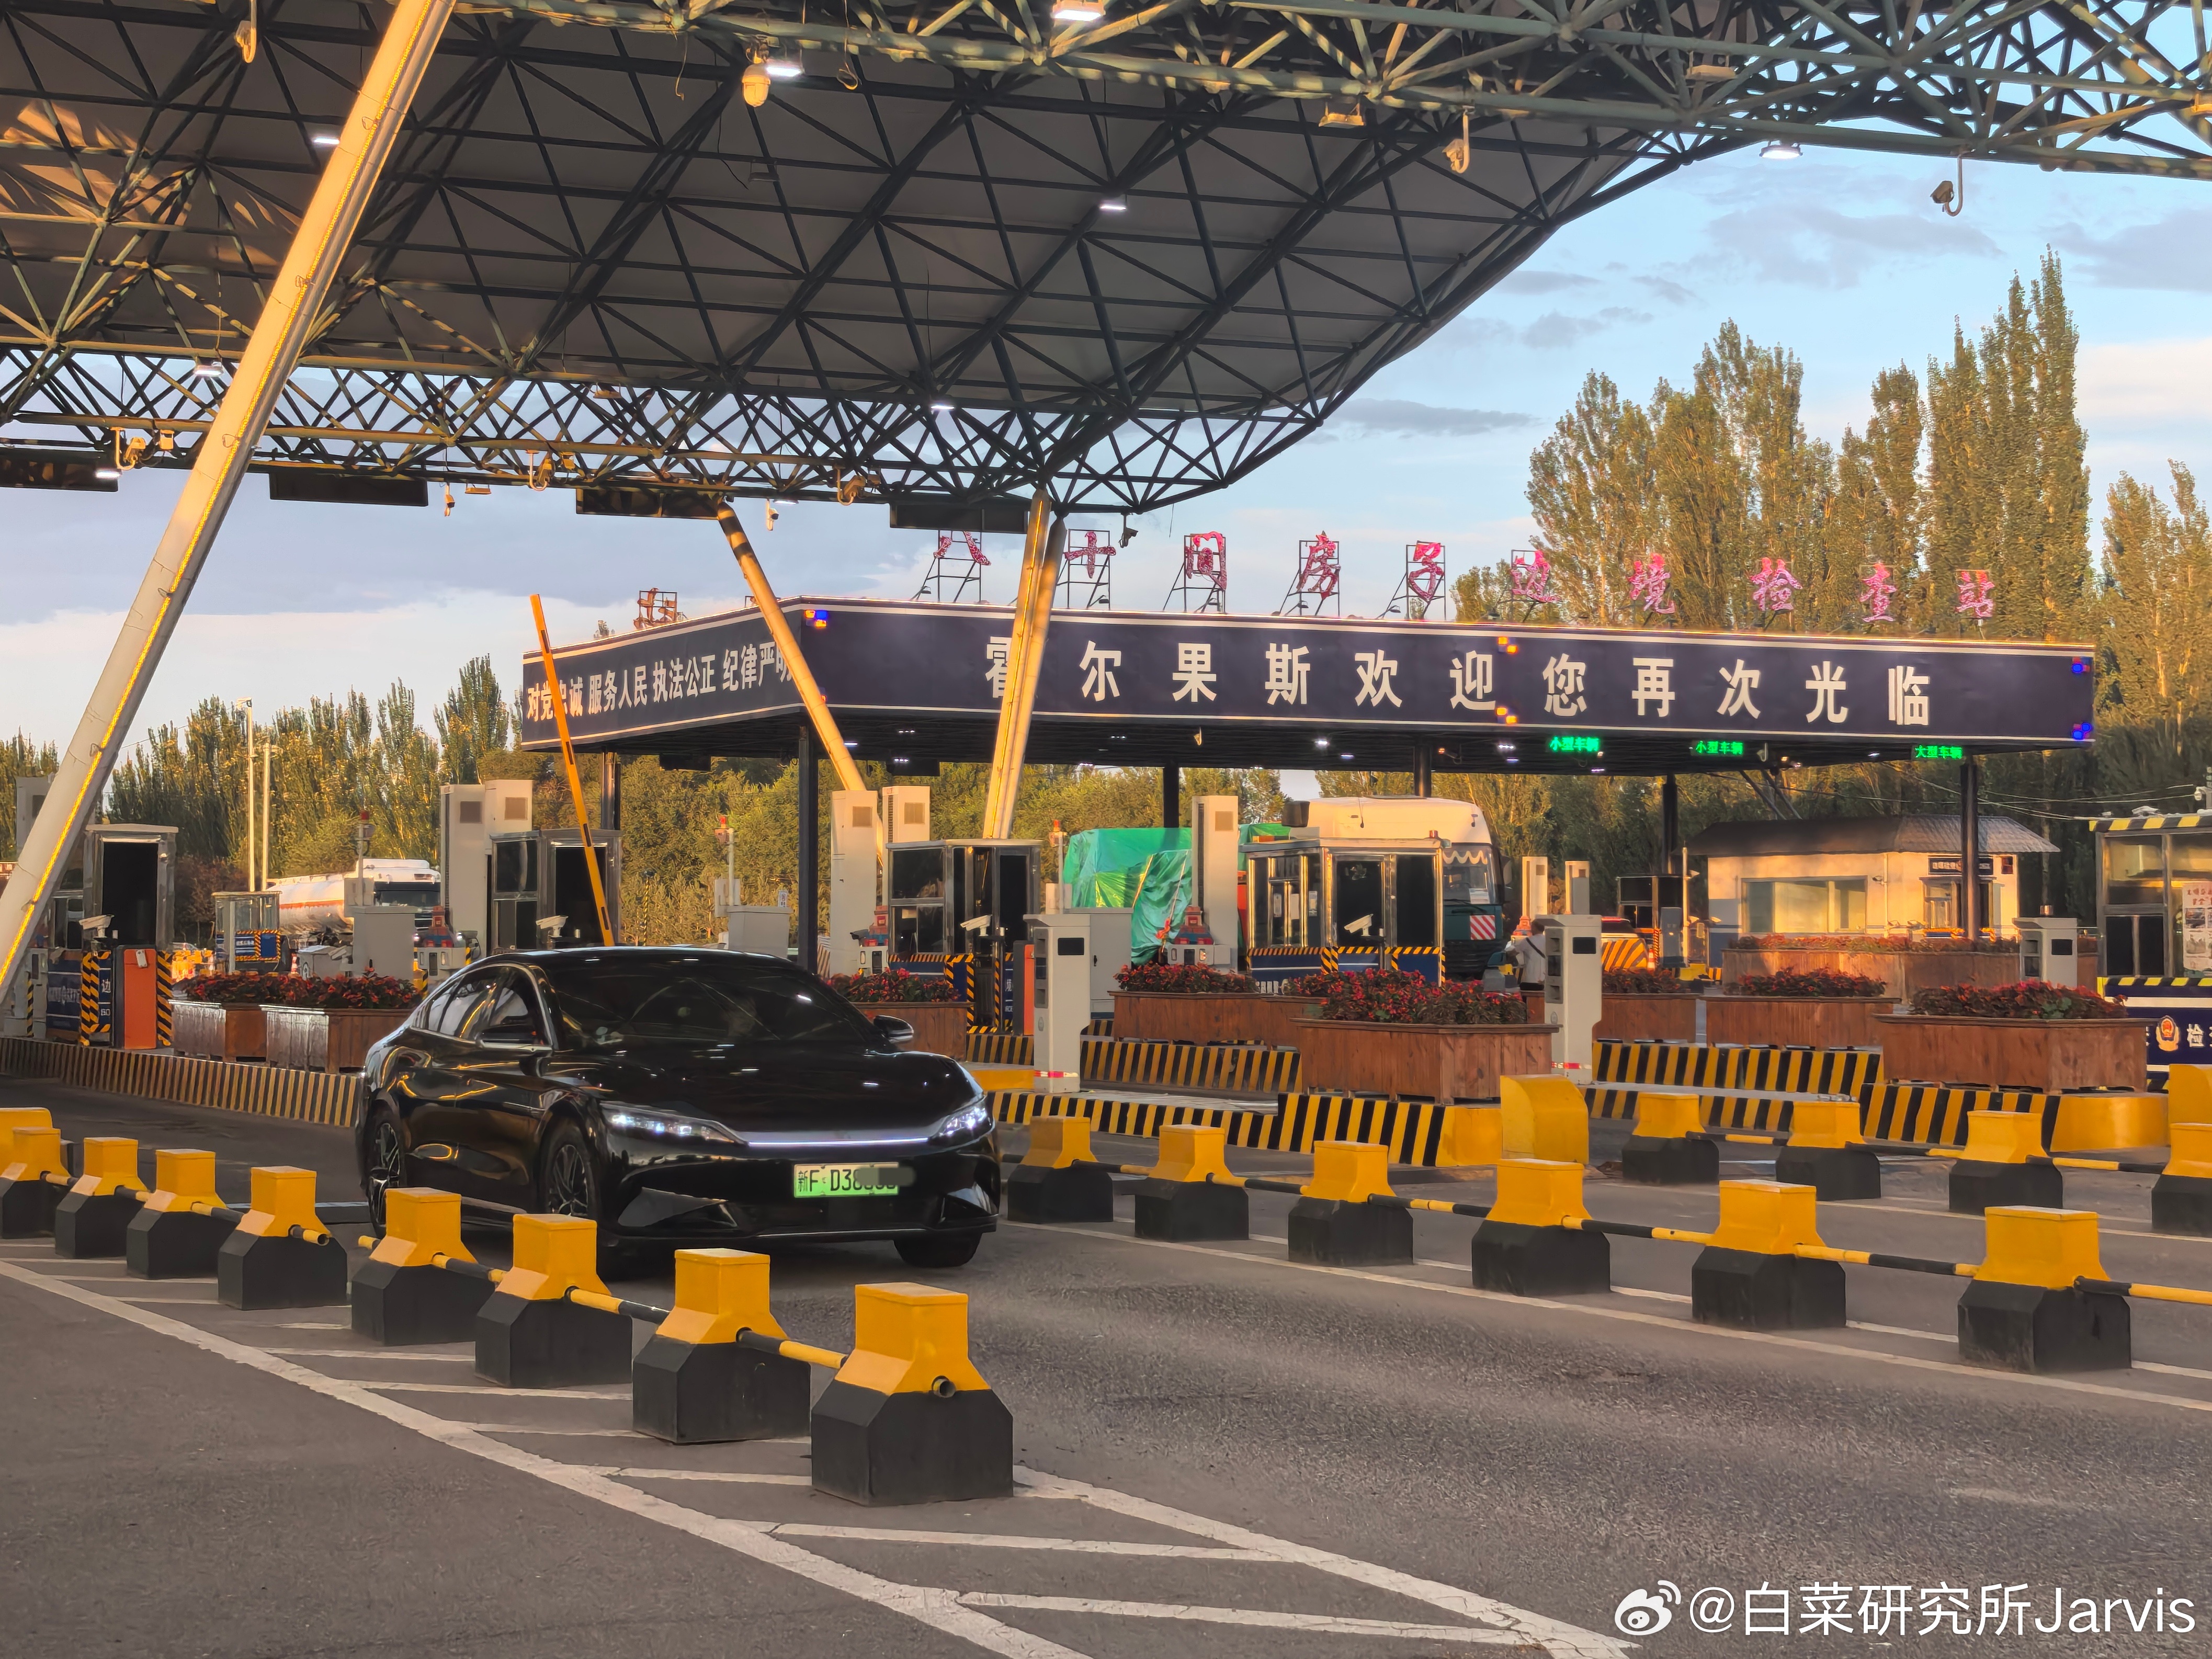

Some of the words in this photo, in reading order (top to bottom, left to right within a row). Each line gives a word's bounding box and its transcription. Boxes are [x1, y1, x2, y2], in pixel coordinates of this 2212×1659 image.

[588, 665, 647, 714] 服务人民
[653, 654, 717, 702] 执法公正
[1550, 736, 1600, 752] 小型车辆
[1696, 741, 1743, 754] 小型车辆
[1915, 745, 1962, 759] 大型车辆
